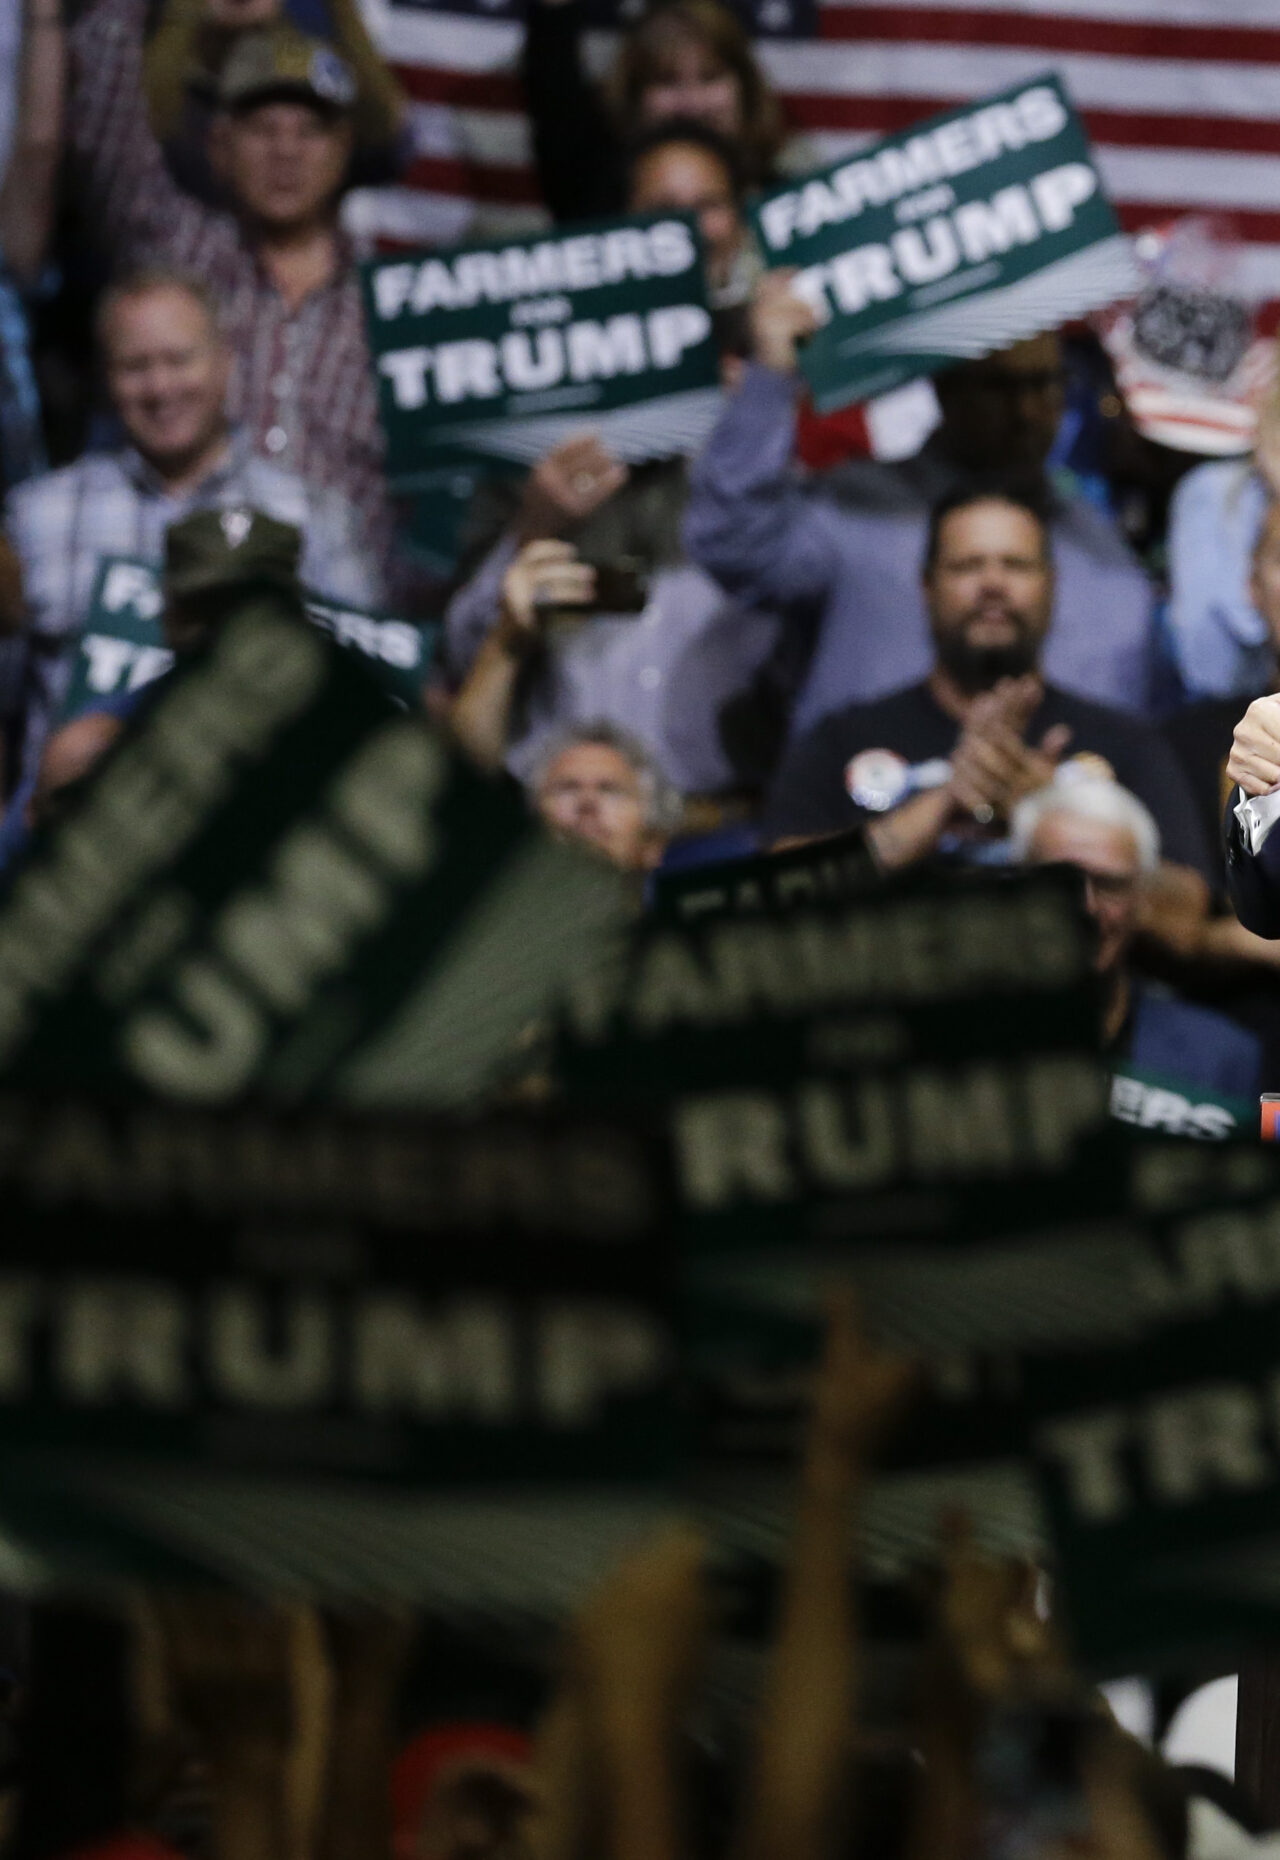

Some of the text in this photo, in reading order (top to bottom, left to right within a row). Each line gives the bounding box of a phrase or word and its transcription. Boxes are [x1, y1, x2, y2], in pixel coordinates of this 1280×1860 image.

[760, 86, 1070, 252] FARMERS
[789, 161, 1098, 325] TRUMP
[373, 219, 697, 321] FARMERS
[379, 303, 712, 410] TRUMP
[668, 1045, 1110, 1213] RUMP
